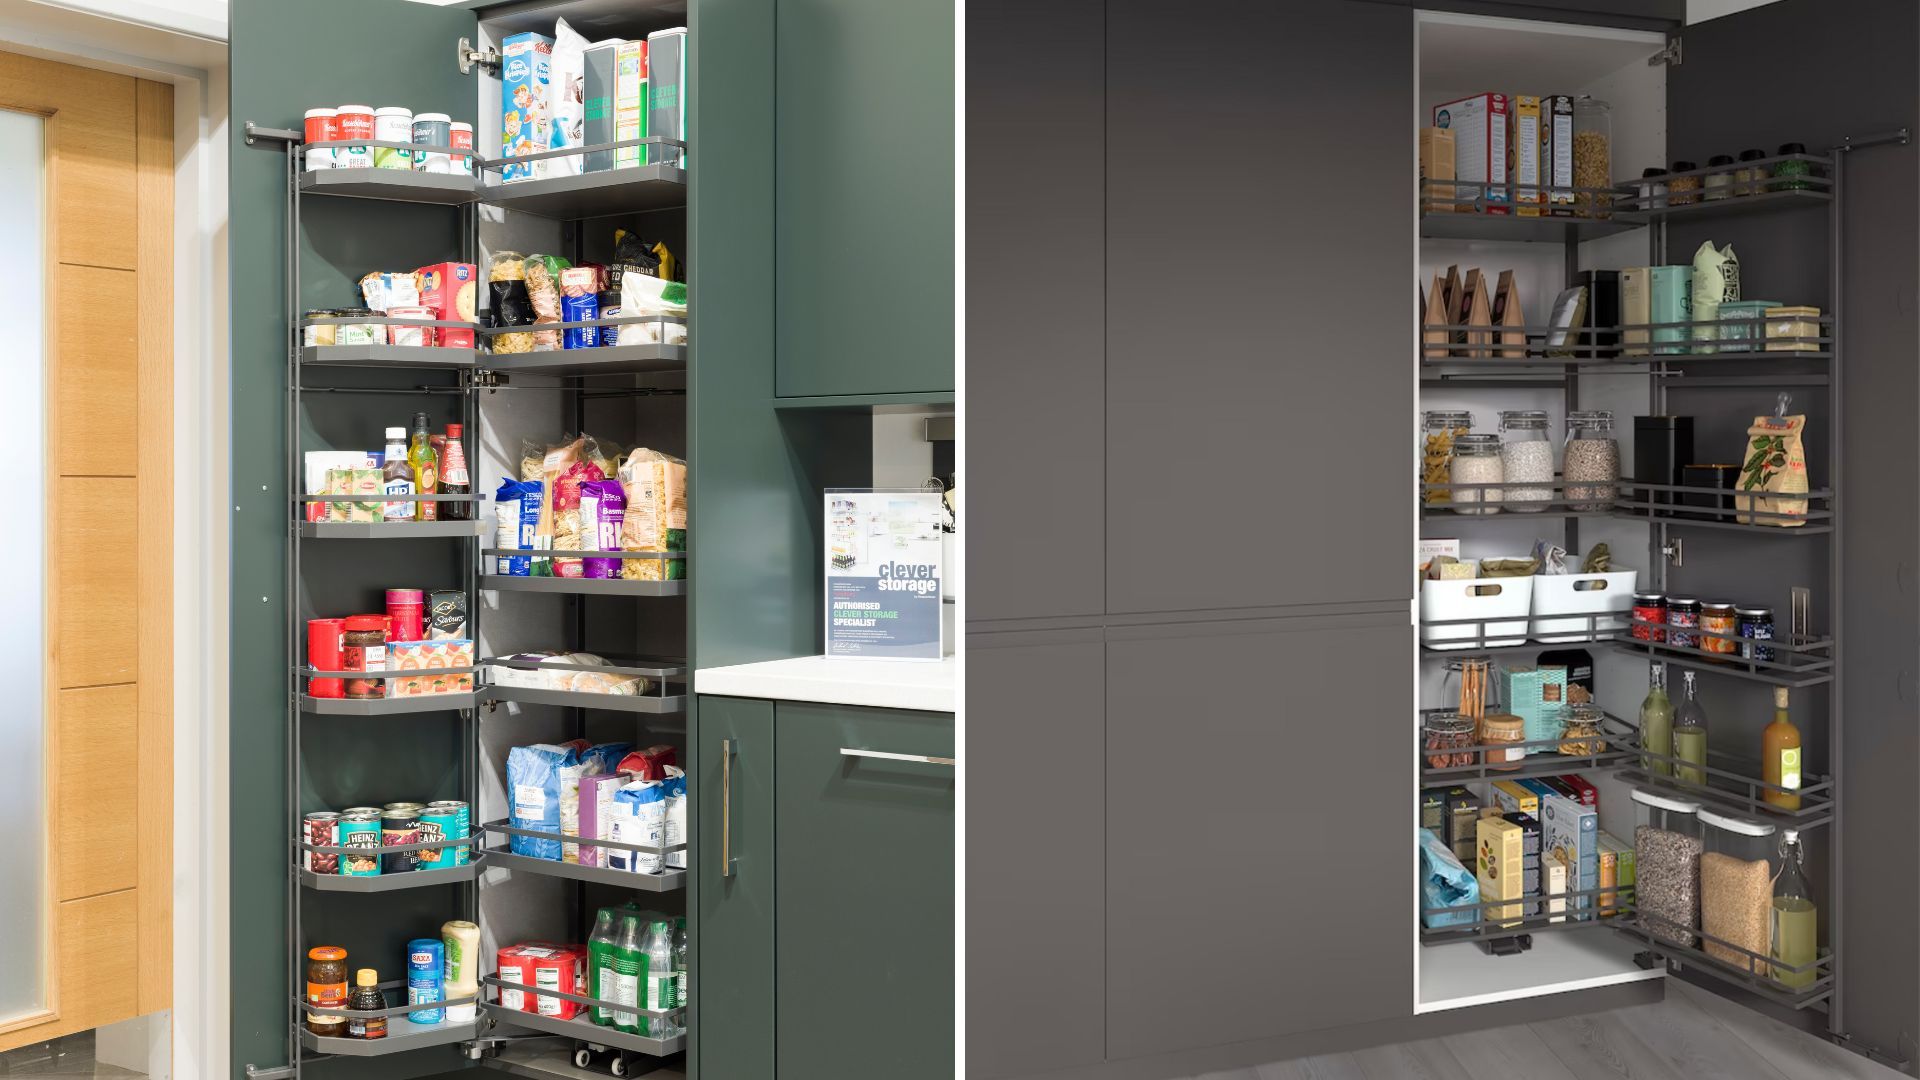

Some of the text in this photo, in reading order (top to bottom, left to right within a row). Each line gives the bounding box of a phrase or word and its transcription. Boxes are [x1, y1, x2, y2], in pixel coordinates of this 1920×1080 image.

[623, 264, 654, 276] CHEDDAR
[878, 561, 937, 578] clever
[878, 576, 937, 594] storage
[833, 601, 880, 610] AUTHORISED
[833, 610, 899, 619] CLEVER STORAGE
[833, 618, 876, 627] SPECIALIST
[351, 833, 375, 843] HEINZ
[412, 954, 431, 962] SAXA
